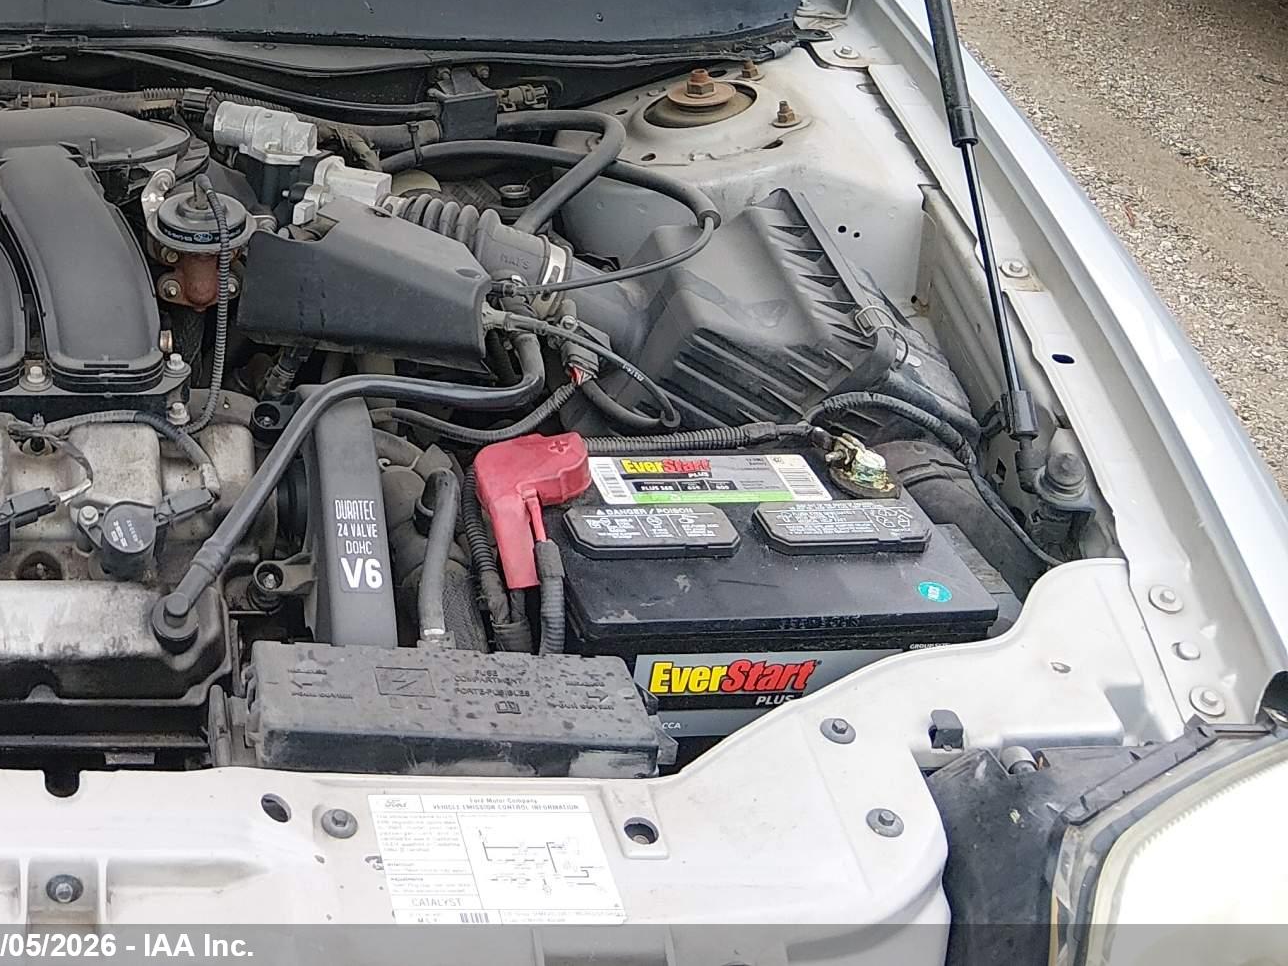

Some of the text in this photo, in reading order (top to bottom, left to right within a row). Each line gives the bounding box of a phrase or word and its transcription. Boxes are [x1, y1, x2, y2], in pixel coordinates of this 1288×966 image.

[620, 458, 712, 474] EverStart
[334, 499, 376, 521] DURATEC
[337, 523, 378, 538] 24 VALVE
[345, 540, 373, 554] DOHC
[340, 557, 383, 588] V6
[649, 658, 818, 694] EverStart
[755, 695, 795, 706] PLUS
[662, 721, 681, 730] CCA
[411, 897, 462, 907] CATALYST
